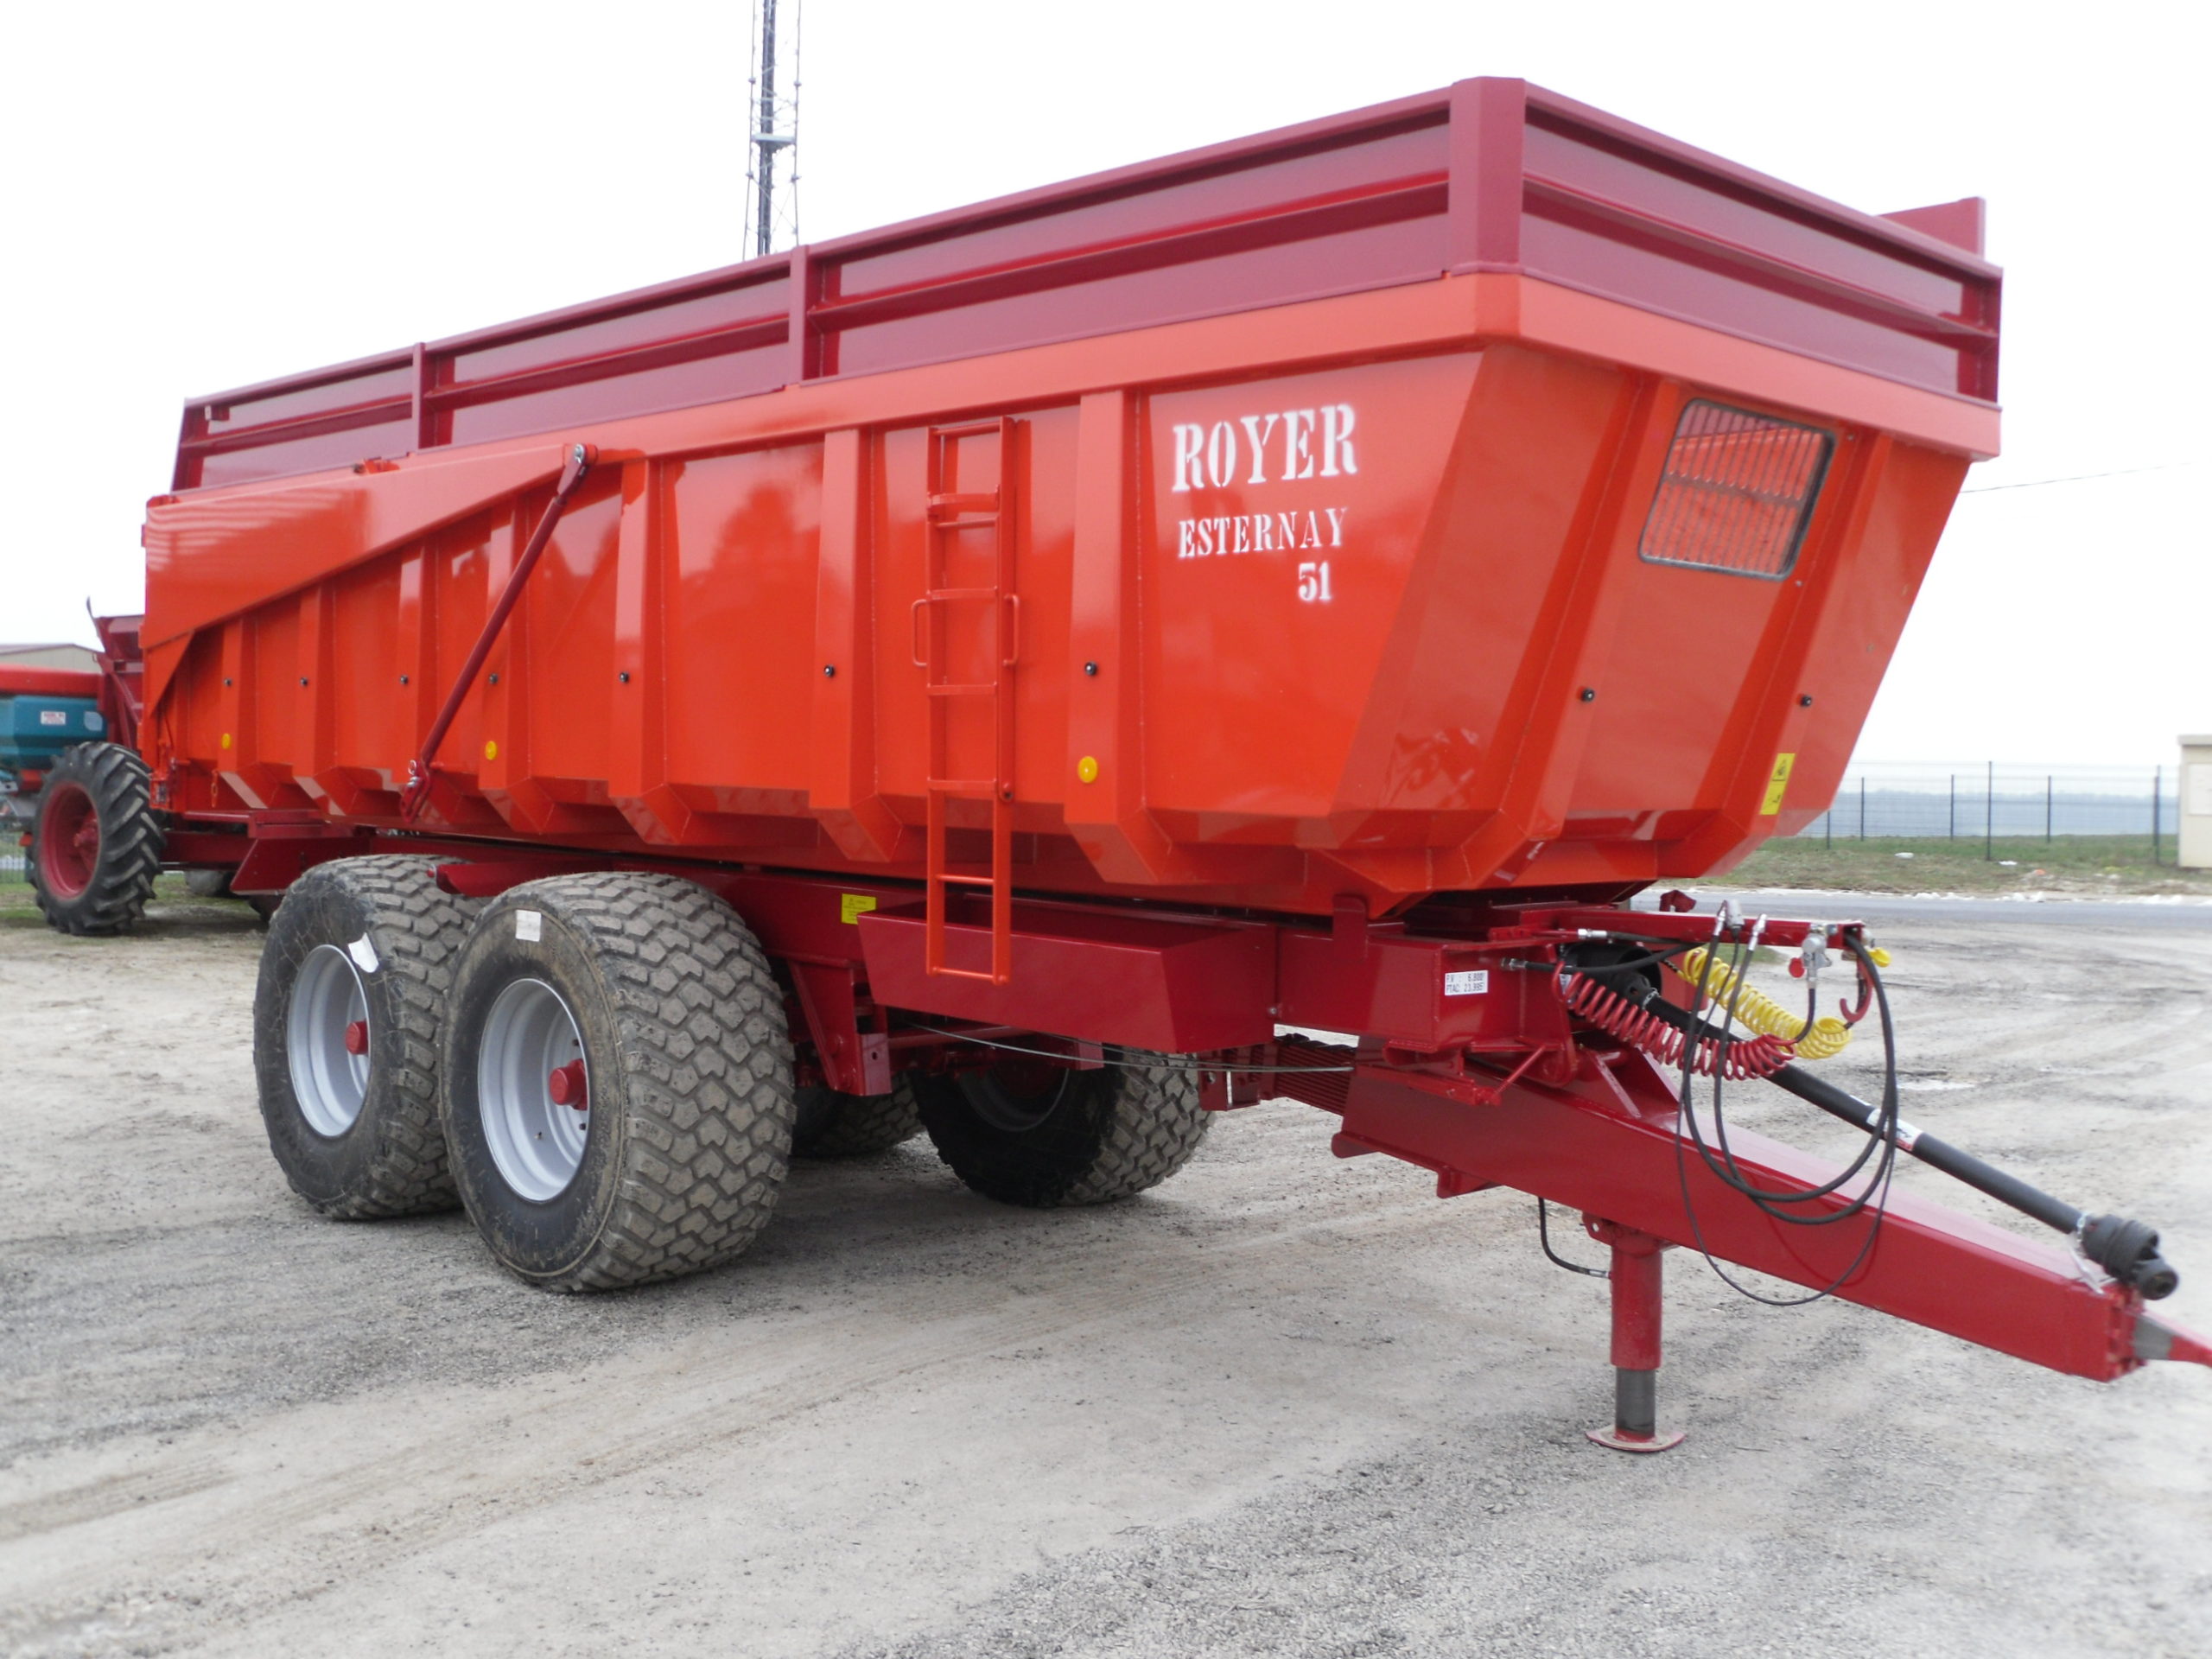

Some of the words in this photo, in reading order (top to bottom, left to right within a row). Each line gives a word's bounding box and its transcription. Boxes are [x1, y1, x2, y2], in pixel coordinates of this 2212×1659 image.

[1172, 404, 1357, 492] ROYER
[1178, 507, 1348, 558] ESTERNAY
[1298, 562, 1332, 602] 51
